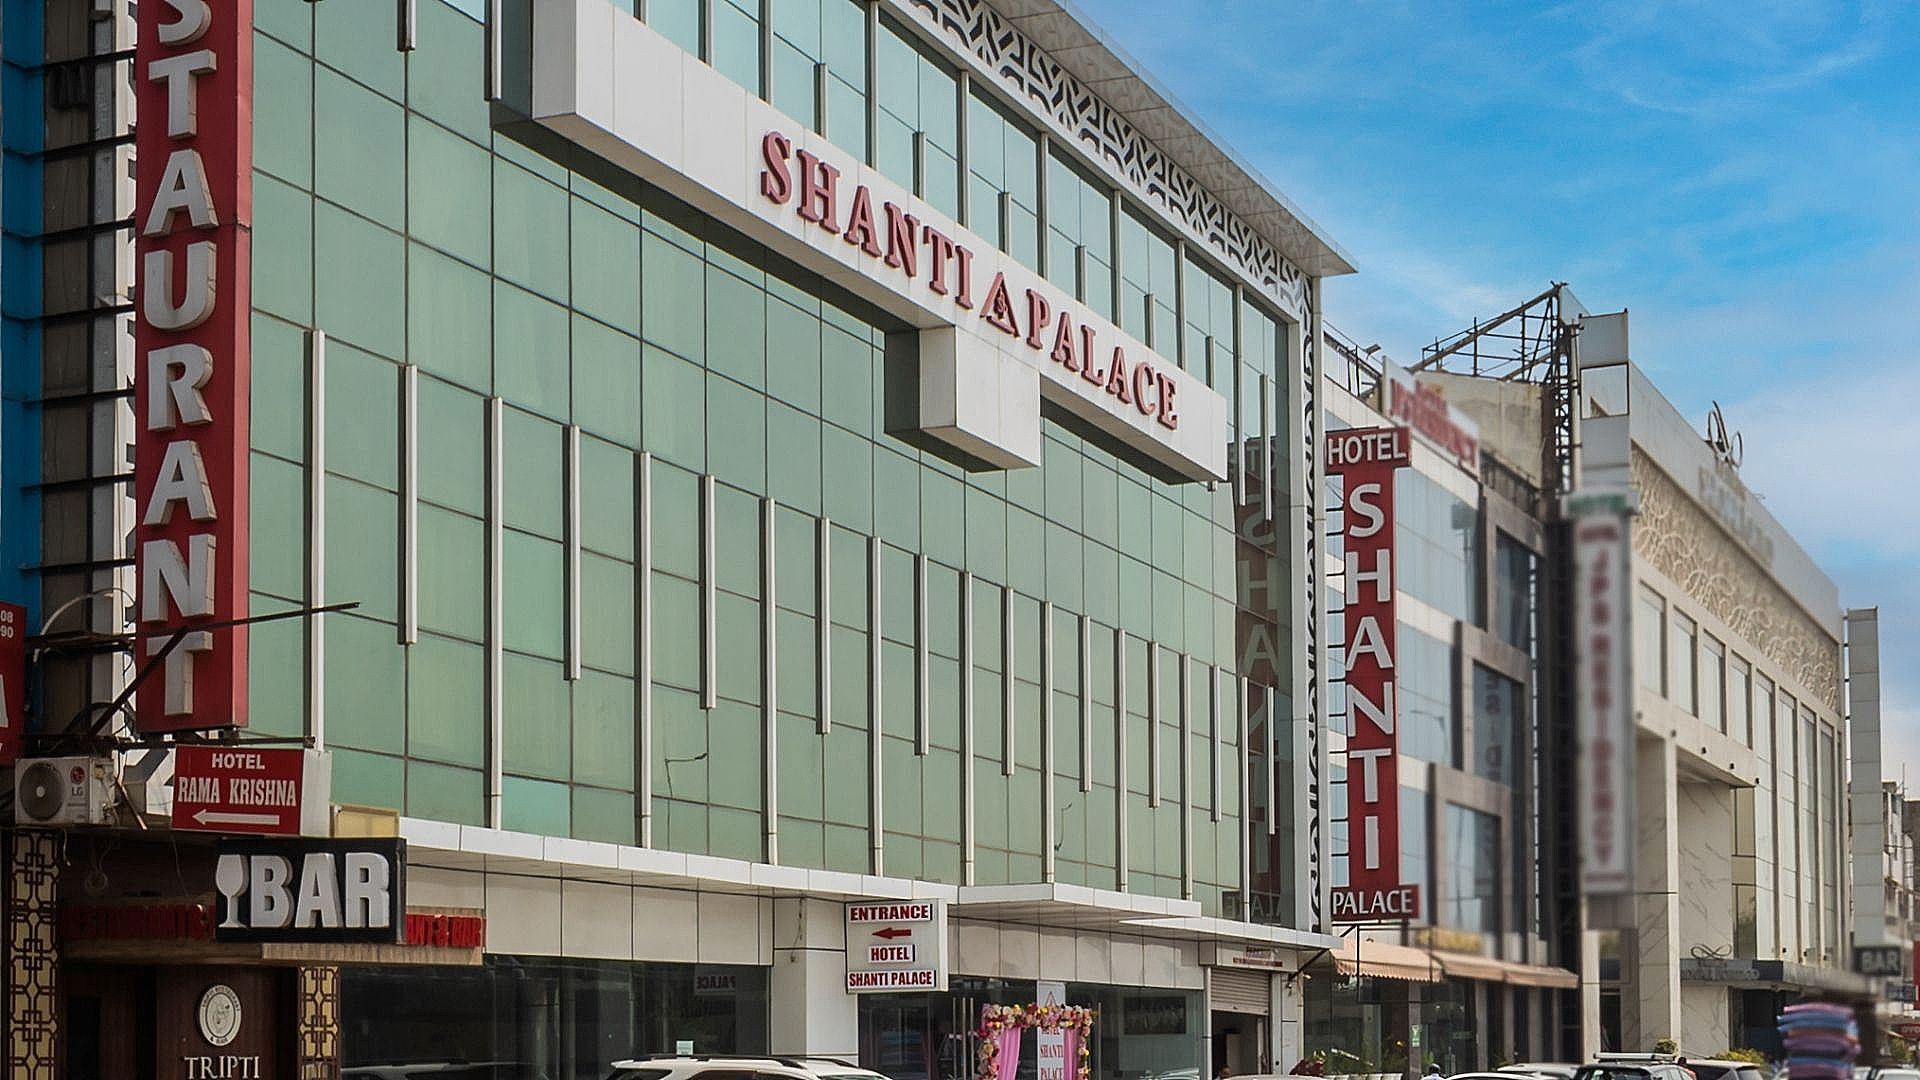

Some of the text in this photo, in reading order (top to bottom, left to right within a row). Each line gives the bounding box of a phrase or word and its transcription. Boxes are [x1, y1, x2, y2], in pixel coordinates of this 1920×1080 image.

[760, 131, 1178, 431] SHANTI PALACE
[1327, 431, 1406, 465] HOTEL
[1345, 482, 1394, 870] SHANTI
[211, 753, 265, 770] HOTEL
[178, 776, 297, 807] RAMA KRISHNA
[250, 851, 390, 929] BAR
[1332, 889, 1412, 915] PALACE
[850, 905, 929, 921] ENTRANCE
[871, 946, 910, 961] HOTEL
[849, 971, 932, 987] SHANTI PALACE
[1040, 1045, 1064, 1058] SHANTI
[184, 1055, 260, 1080] TRIPTI
